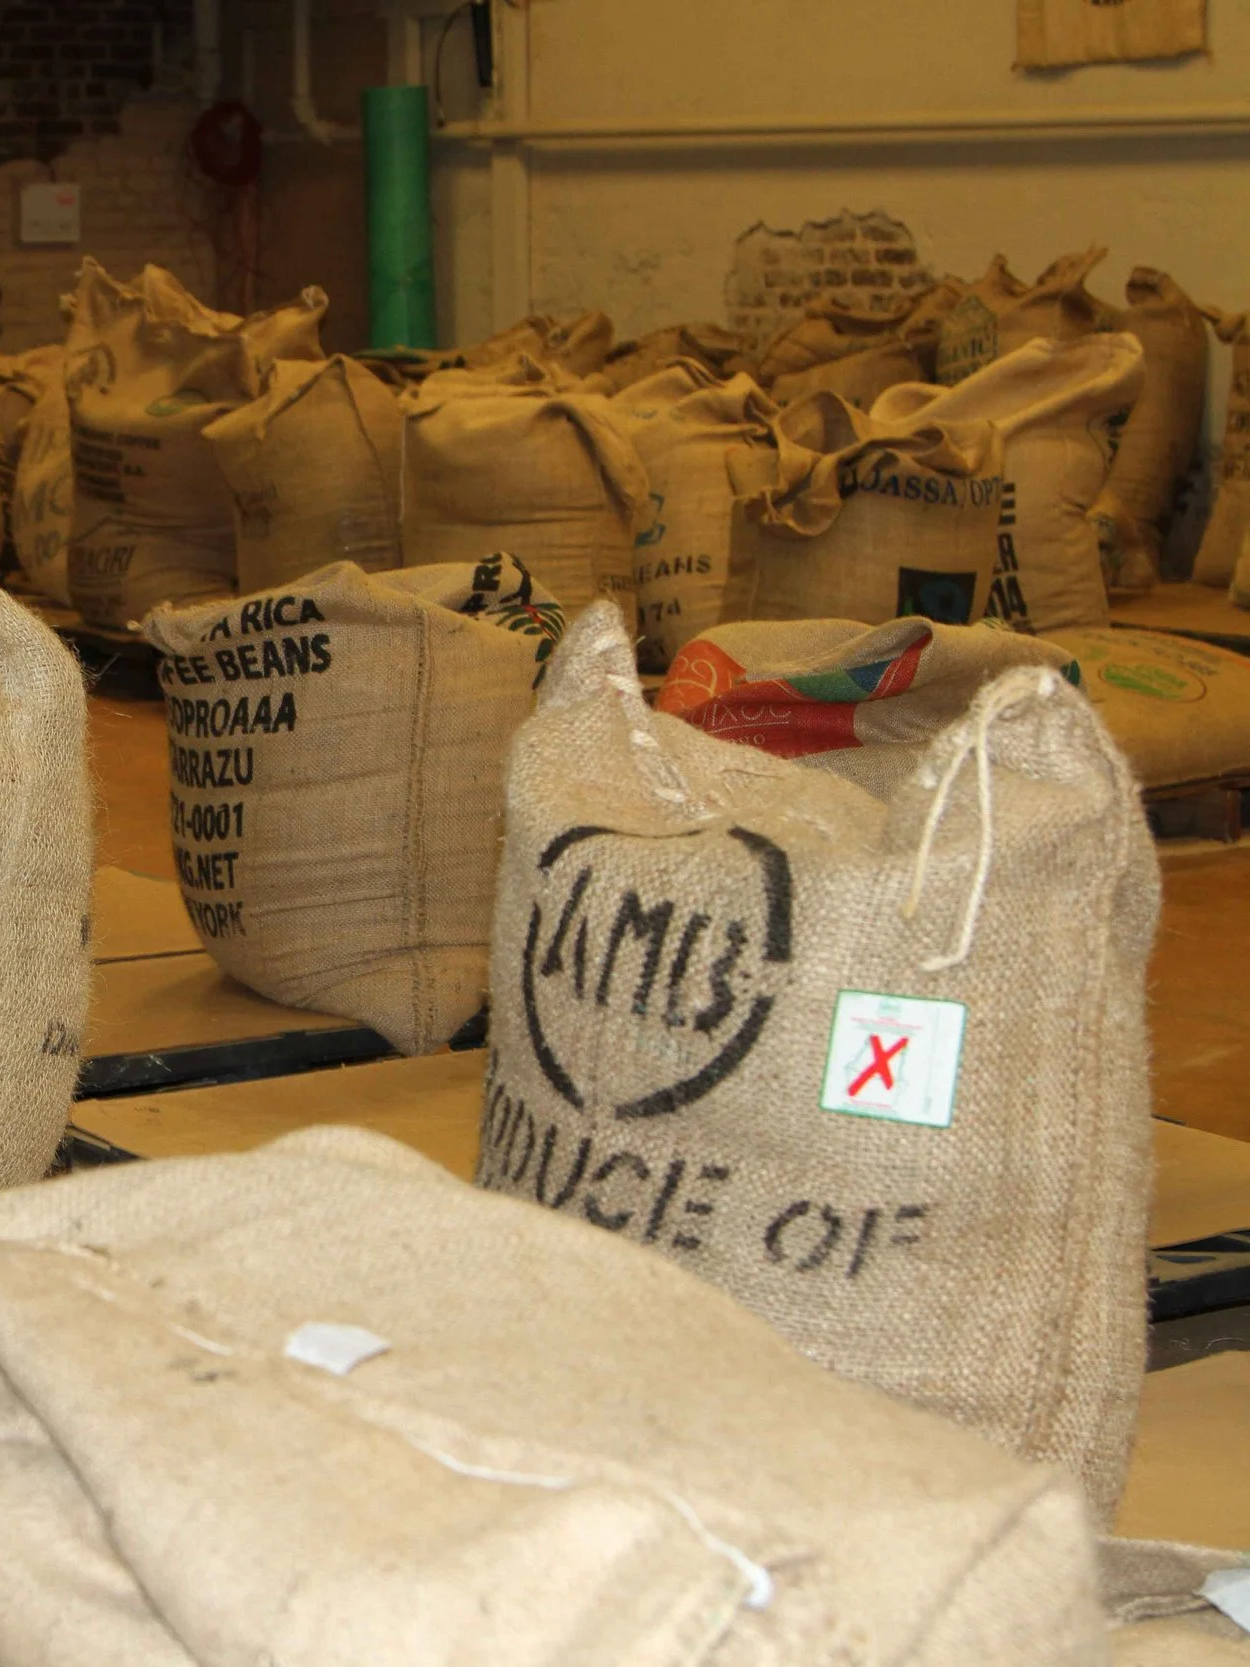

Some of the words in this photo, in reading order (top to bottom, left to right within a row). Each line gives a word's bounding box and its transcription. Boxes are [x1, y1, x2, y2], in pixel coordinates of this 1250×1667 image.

[240, 596, 326, 635] RICA
[215, 633, 332, 681] BEANS
[169, 692, 297, 738] OPROAAA
[171, 746, 253, 788] ARRAZU
[483, 1072, 732, 1250] ODUCE
[762, 1199, 934, 1281] OF
